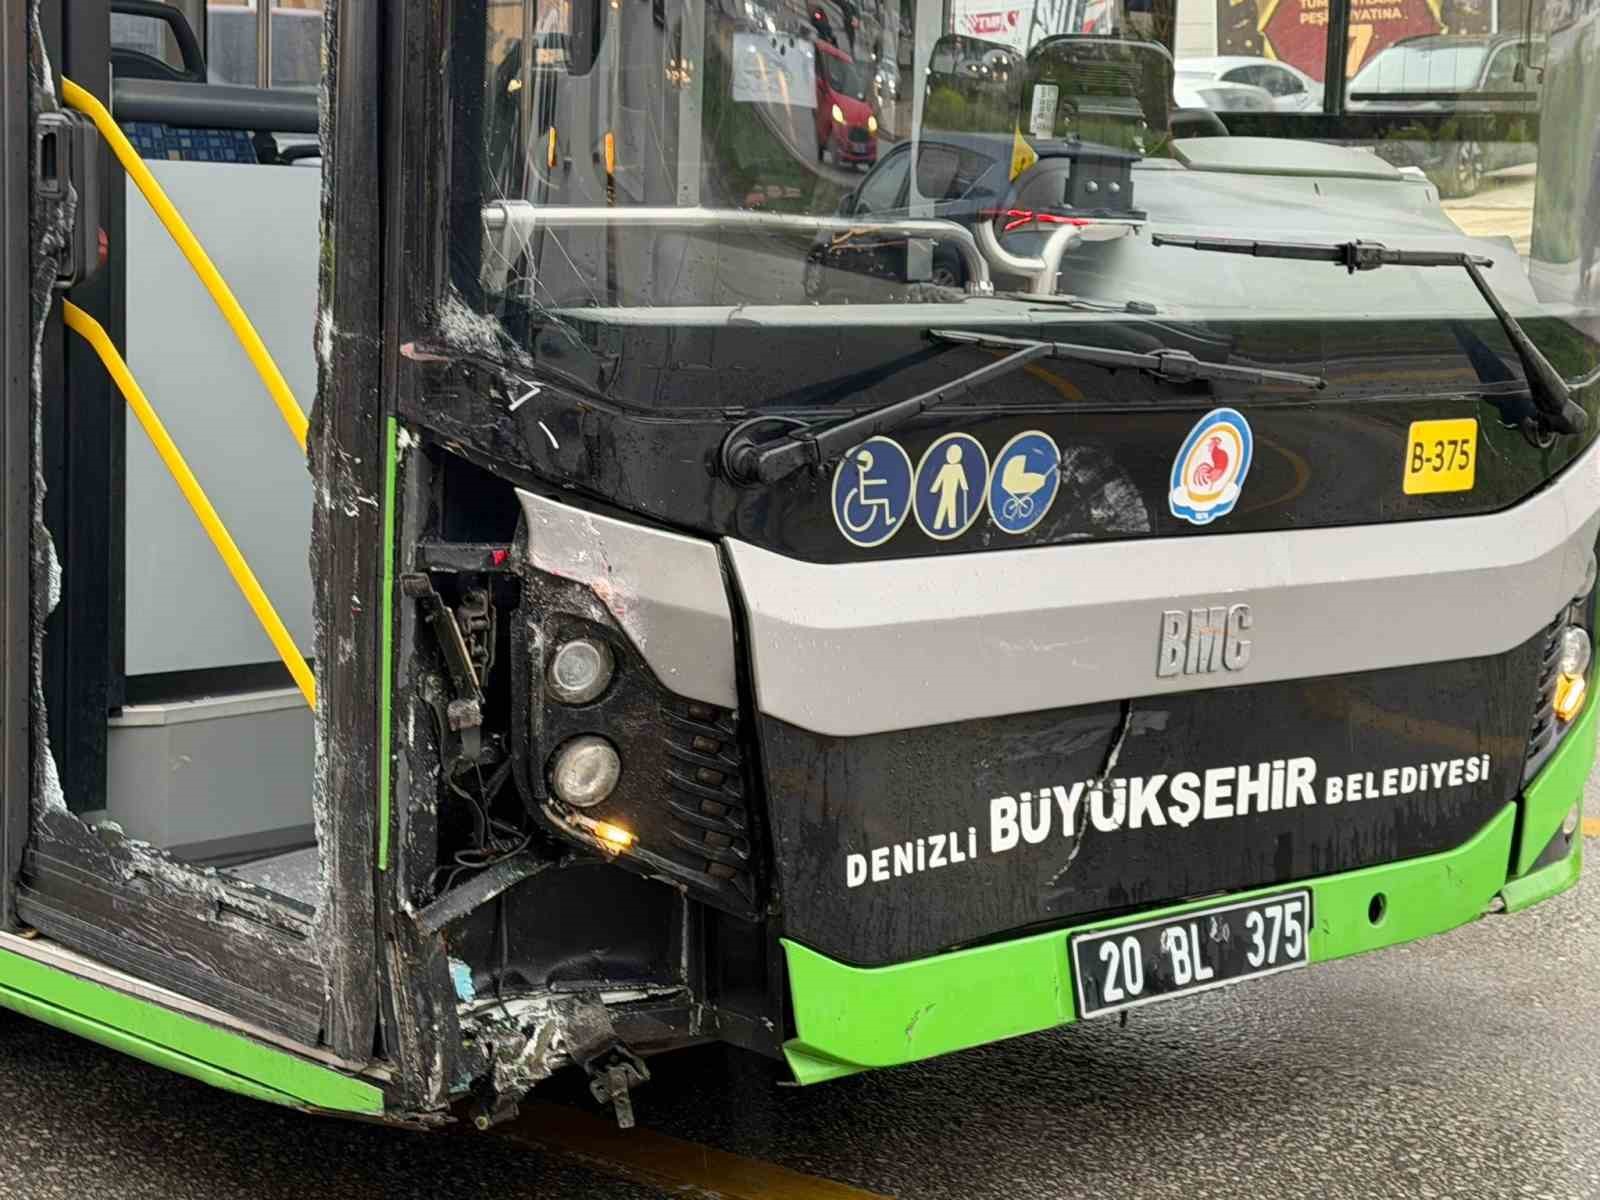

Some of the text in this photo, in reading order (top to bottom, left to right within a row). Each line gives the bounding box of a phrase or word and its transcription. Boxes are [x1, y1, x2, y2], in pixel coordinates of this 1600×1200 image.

[1346, 24, 1374, 76] 7
[1411, 440, 1470, 474] B-375
[1156, 603, 1252, 678] BMC
[846, 754, 1490, 888] DENİZLİ BÜYÜKŞEHİR BELEDİYESİ
[1100, 902, 1302, 1002] 20 BL 375
